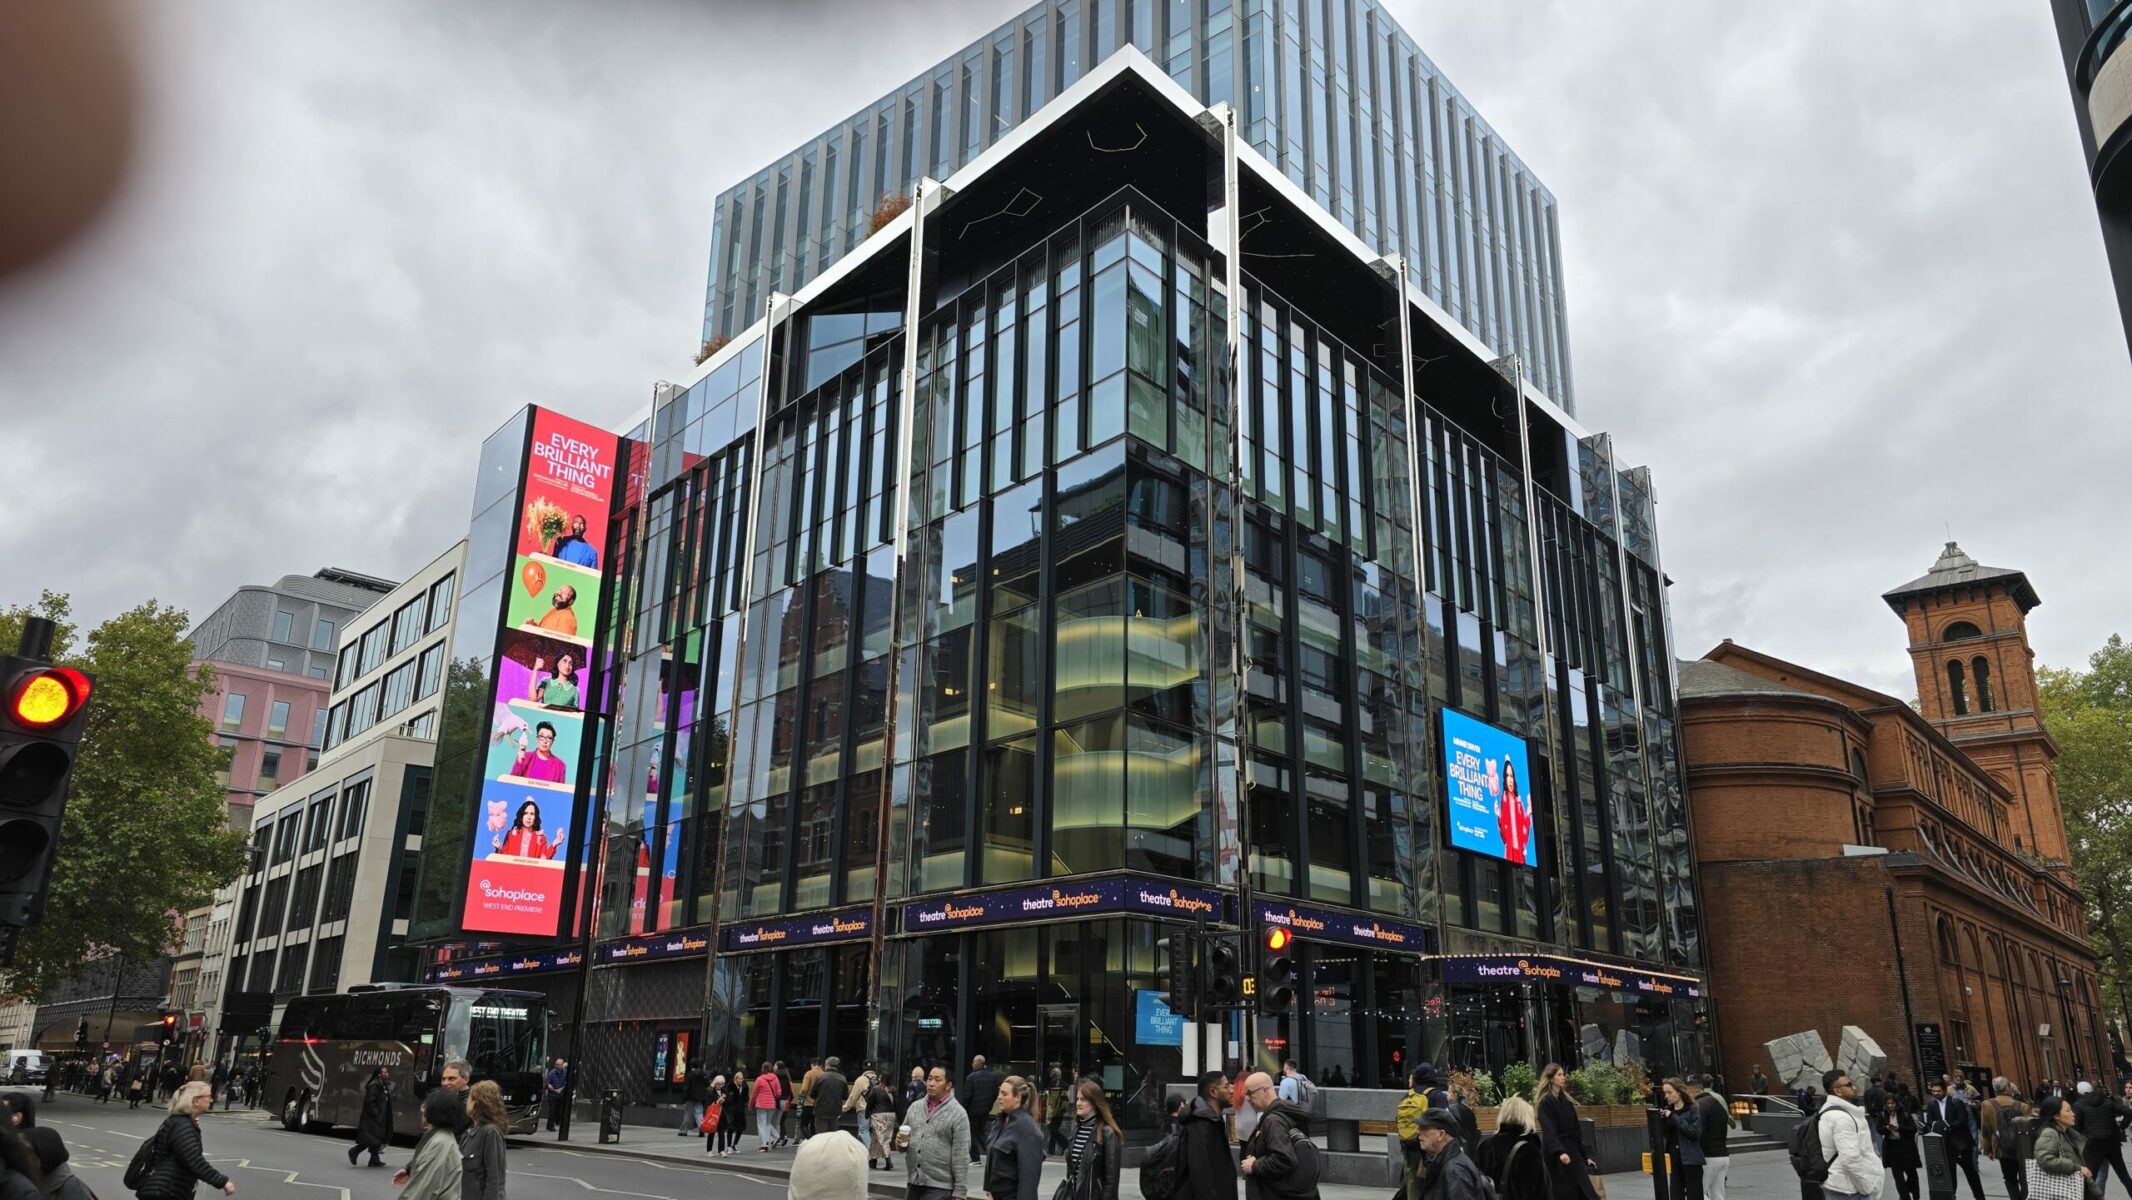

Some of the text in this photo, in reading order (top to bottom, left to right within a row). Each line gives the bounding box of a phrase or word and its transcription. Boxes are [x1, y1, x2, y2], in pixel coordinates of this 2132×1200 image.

[551, 432, 599, 460] EVERY
[534, 441, 611, 479] BRILLIANT
[547, 460, 595, 488] THING
[1456, 751, 1480, 771] EVERY
[1450, 763, 1489, 788] BRILLIANT
[1458, 781, 1483, 801] THING
[480, 879, 545, 902] @sohoplace
[483, 902, 543, 914] WEST END PREMIERE
[1150, 1016, 1178, 1026] BRILLIANT
[1155, 1025, 1173, 1034] THING
[353, 1050, 401, 1066] RICHMONDS
